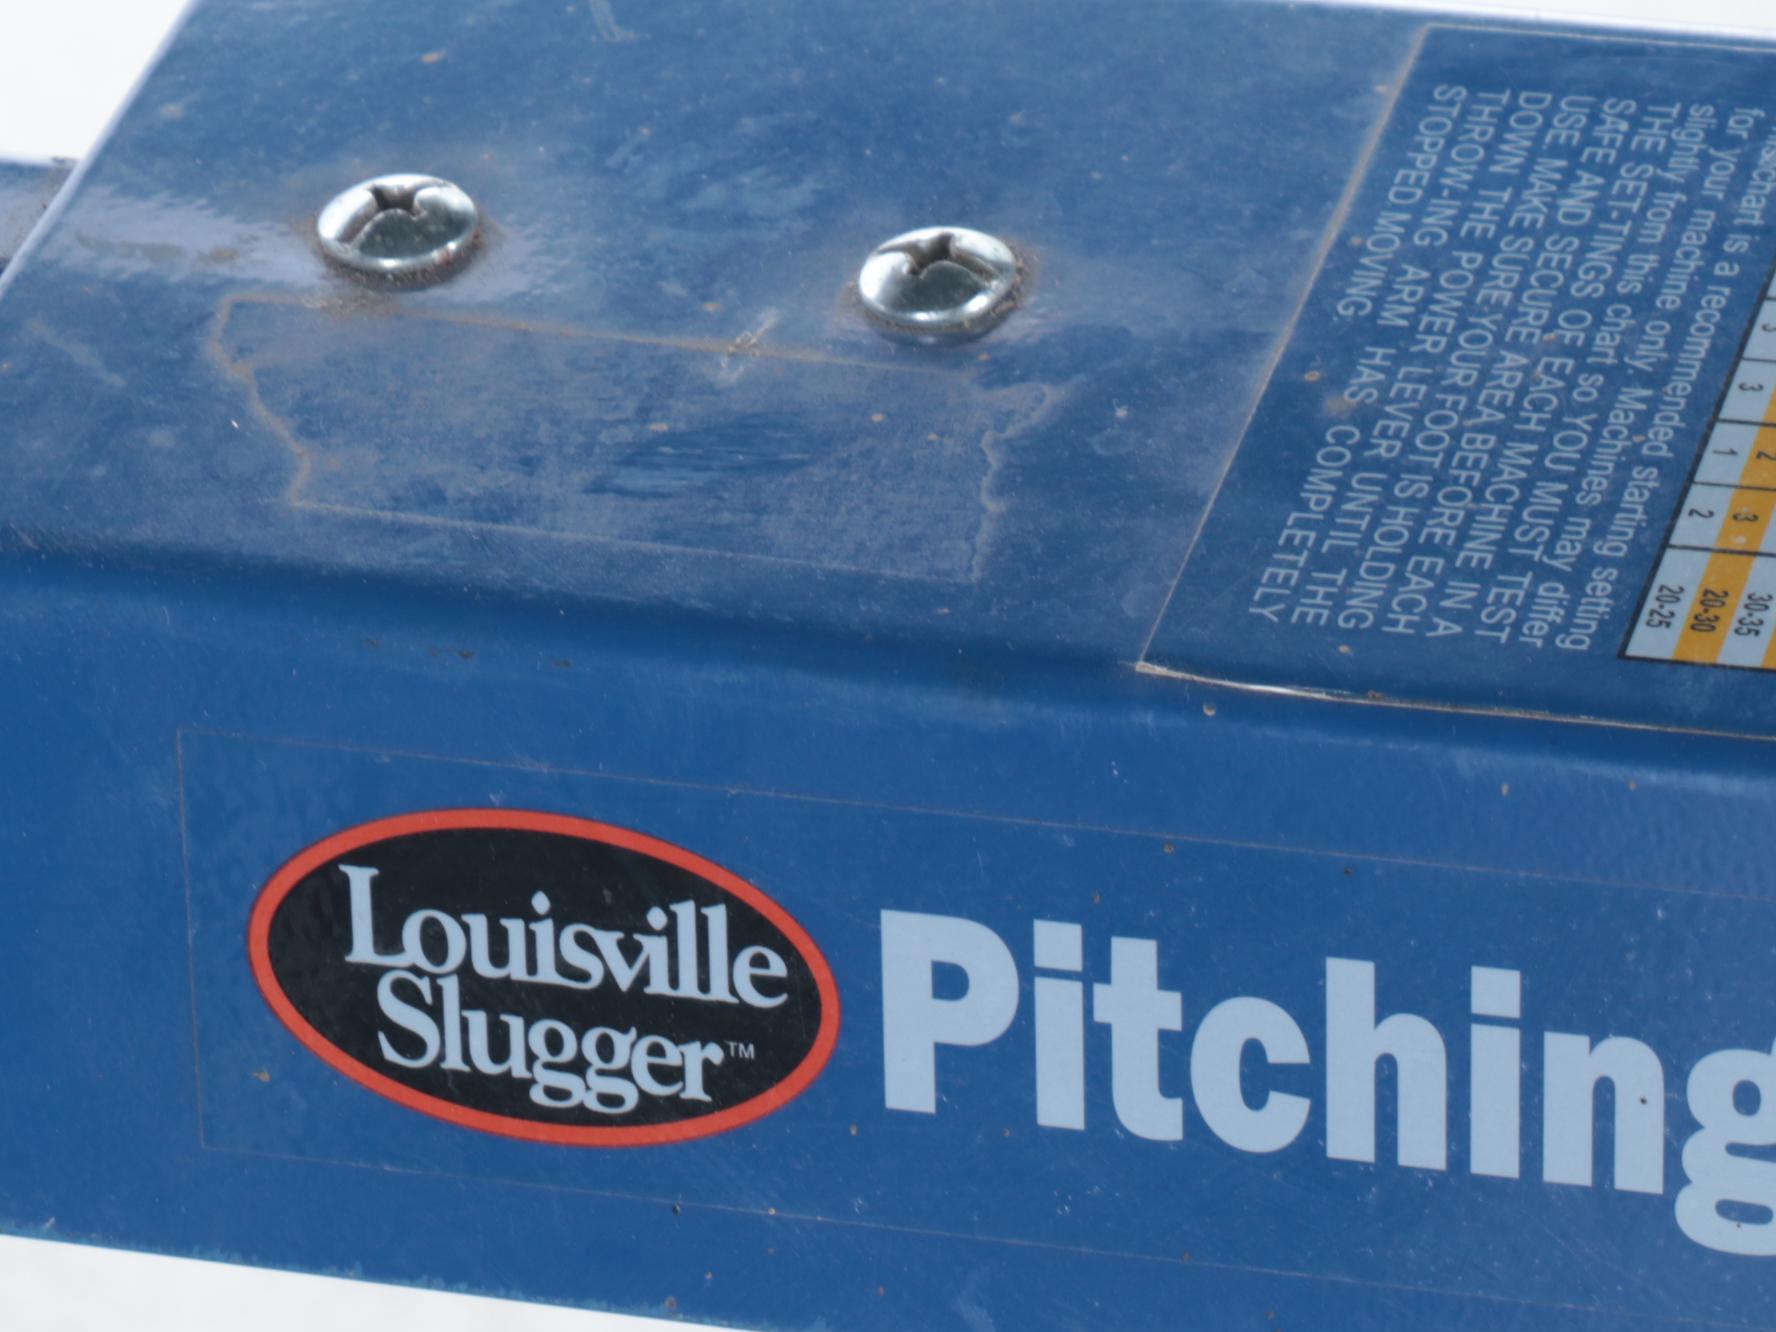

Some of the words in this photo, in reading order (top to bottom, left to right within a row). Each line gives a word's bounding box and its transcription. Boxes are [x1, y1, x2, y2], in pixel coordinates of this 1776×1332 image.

[1387, 85, 1468, 205] STOPPED
[1488, 91, 1553, 175] DOWN
[1541, 94, 1596, 150] USE.
[1579, 97, 1637, 165] SAFE
[1629, 102, 1682, 153] THE
[1655, 104, 1717, 184] slightly
[1725, 107, 1766, 140] for
[1412, 89, 1511, 247] THROW-ING
[1508, 157, 1568, 230] MAKE
[1556, 169, 1605, 226] AND
[1700, 147, 1742, 201] your
[1459, 186, 1513, 239] THE
[1569, 161, 1660, 298] SET-TINGS
[1636, 191, 1688, 244] from
[1722, 233, 1760, 254] is
[1377, 263, 1431, 327] ARM
[1475, 234, 1535, 307] SURE
[1504, 233, 1581, 345] SECURE
[1615, 252, 1661, 295] this
[1654, 208, 1717, 311] machine
[1713, 261, 1741, 277] a
[1409, 250, 1484, 354] POWER
[1546, 308, 1593, 347] OF
[1586, 303, 1637, 365] chart
[1335, 346, 1397, 406] HAS
[1440, 313, 1504, 387] YOUR
[1623, 319, 1672, 374] only.
[1640, 284, 1732, 458] recommended
[1363, 365, 1434, 459] LEVER
[1463, 349, 1531, 425] AREA
[1513, 355, 1575, 432] EACH
[1571, 372, 1605, 403] so
[1407, 392, 1468, 469] FOOT
[1543, 412, 1598, 472] YOU
[1575, 385, 1655, 506] Machines
[1320, 471, 1388, 554] UNTIL
[1393, 473, 1433, 499] IS
[1418, 431, 1497, 547] BEFORE
[1454, 441, 1540, 570] MACHINE
[1508, 480, 1569, 562] MUST
[1594, 466, 1661, 558] starting
[1248, 424, 1361, 623] COMPLETELY
[1541, 516, 1593, 572] may
[1290, 567, 1348, 626] THE
[1337, 505, 1421, 629] HOLDING
[1381, 555, 1445, 634] EACH
[1438, 580, 1481, 610] IN
[1425, 616, 1464, 638] A
[1474, 571, 1533, 644] TEST
[1518, 581, 1571, 648] differ
[1556, 566, 1619, 651] setting
[1645, 584, 1685, 629] 20-25
[1689, 587, 1730, 633] 20-30
[1733, 592, 1774, 637] 30-35
[338, 863, 789, 1009] Louisville
[376, 969, 725, 1115] Slugger
